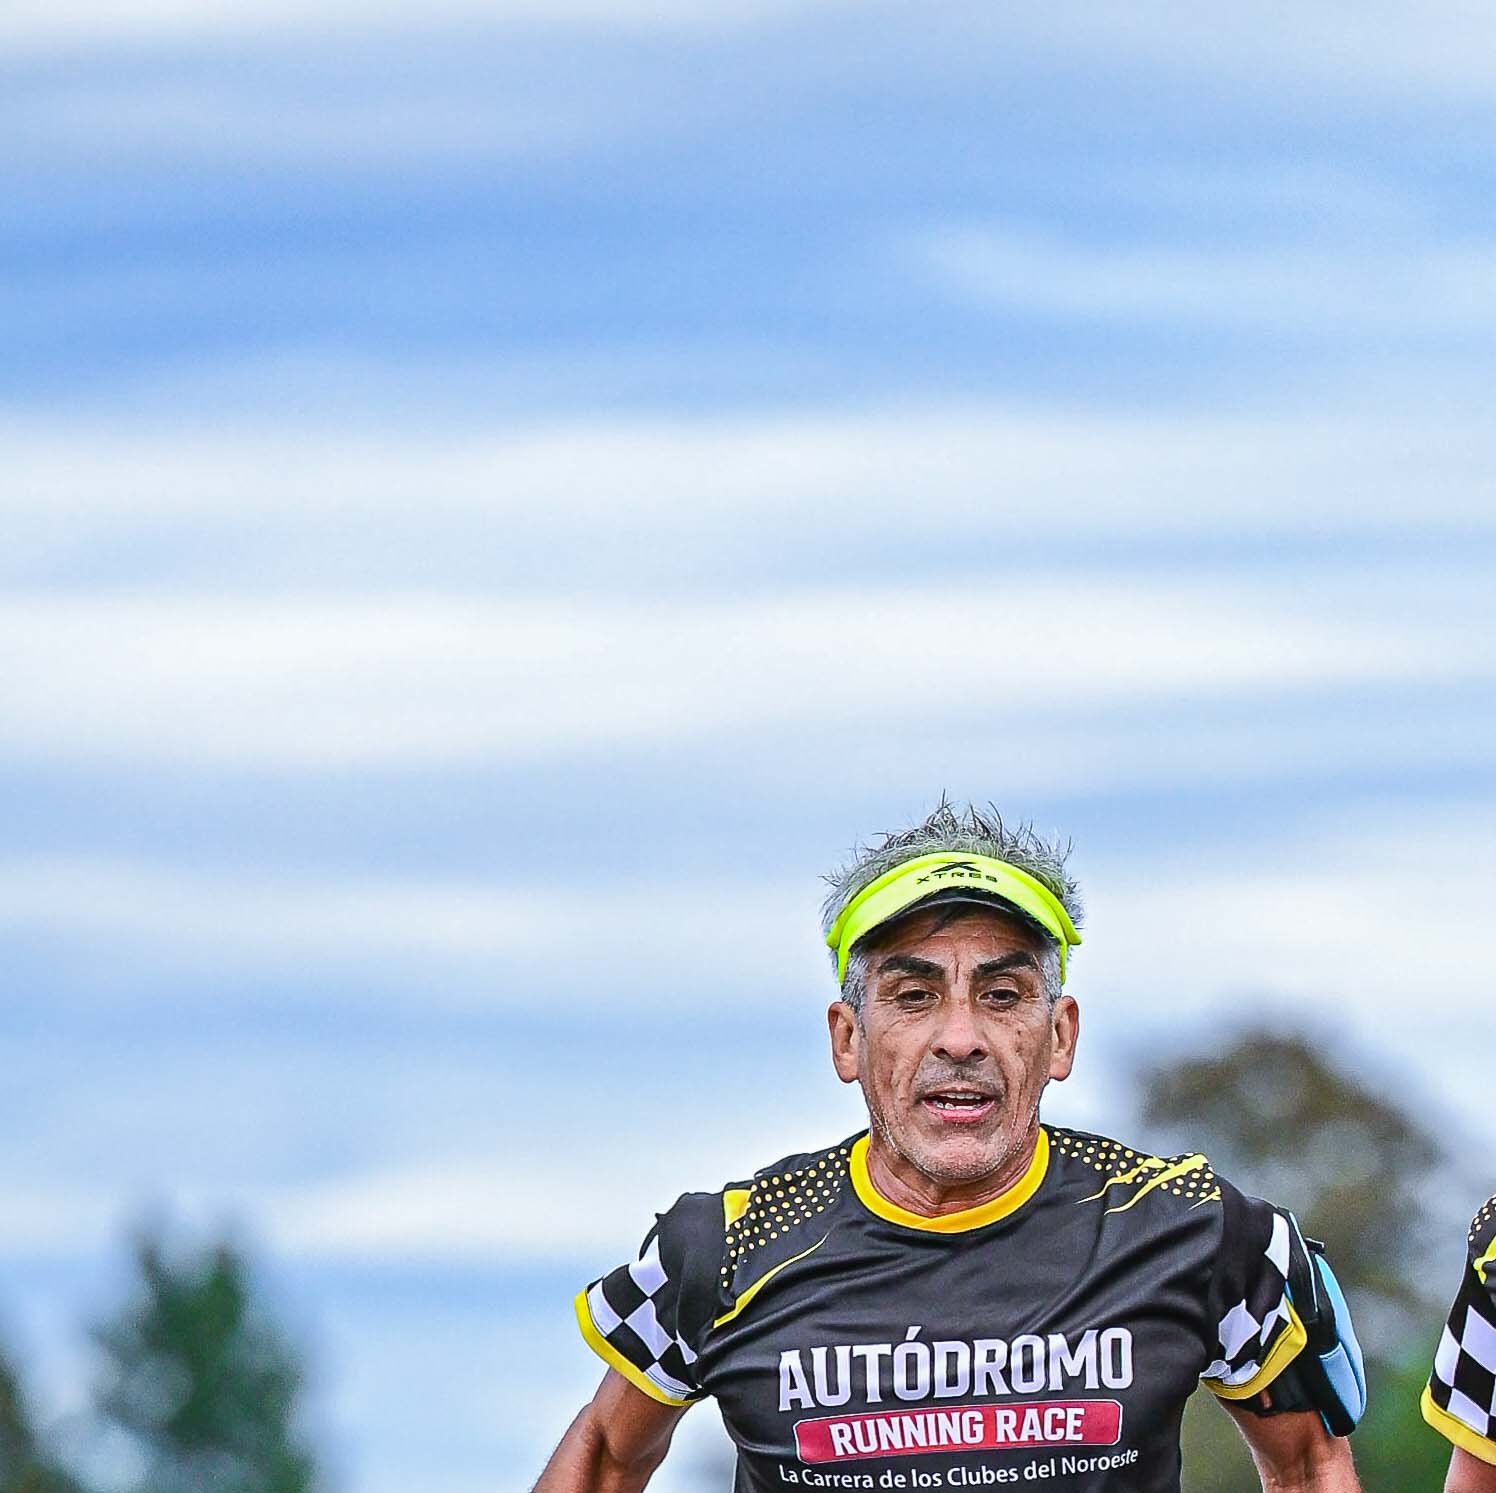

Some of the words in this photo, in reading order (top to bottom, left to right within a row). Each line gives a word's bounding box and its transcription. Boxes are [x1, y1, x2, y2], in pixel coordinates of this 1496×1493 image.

[778, 1326, 1133, 1412] AUTÓDROMO
[829, 1411, 984, 1457] RUNNING
[995, 1407, 1085, 1443] RACE
[779, 1464, 799, 1484] La
[801, 1468, 874, 1489] Carrera
[879, 1469, 907, 1488] de
[911, 1468, 943, 1488] los
[947, 1465, 1018, 1487] Clubes
[1023, 1458, 1055, 1480] del
[1061, 1449, 1139, 1475] Noroeste
